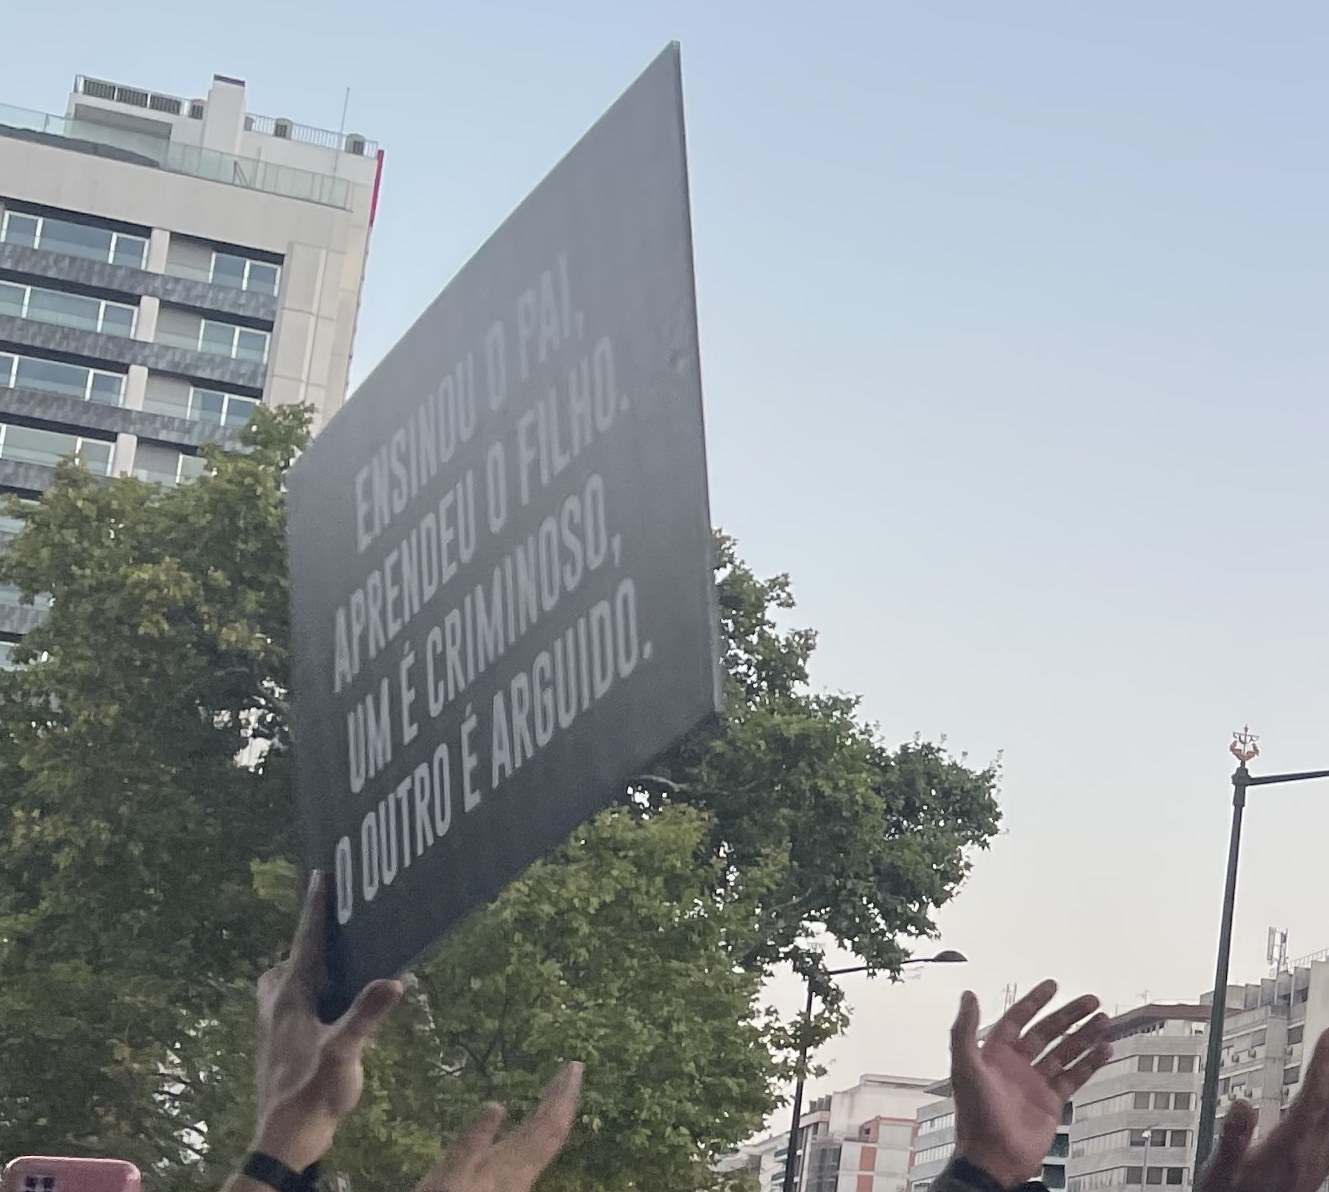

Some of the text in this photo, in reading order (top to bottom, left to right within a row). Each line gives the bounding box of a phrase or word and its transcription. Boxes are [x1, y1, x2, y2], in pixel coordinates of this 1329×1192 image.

[334, 335, 630, 694] APRENDEU O FILHO.
[355, 252, 585, 554] ENSINOU O PAI,
[335, 577, 653, 925] O OUTRO É ARGUIDO.
[348, 473, 621, 794] UM É CRIMINOSO,
